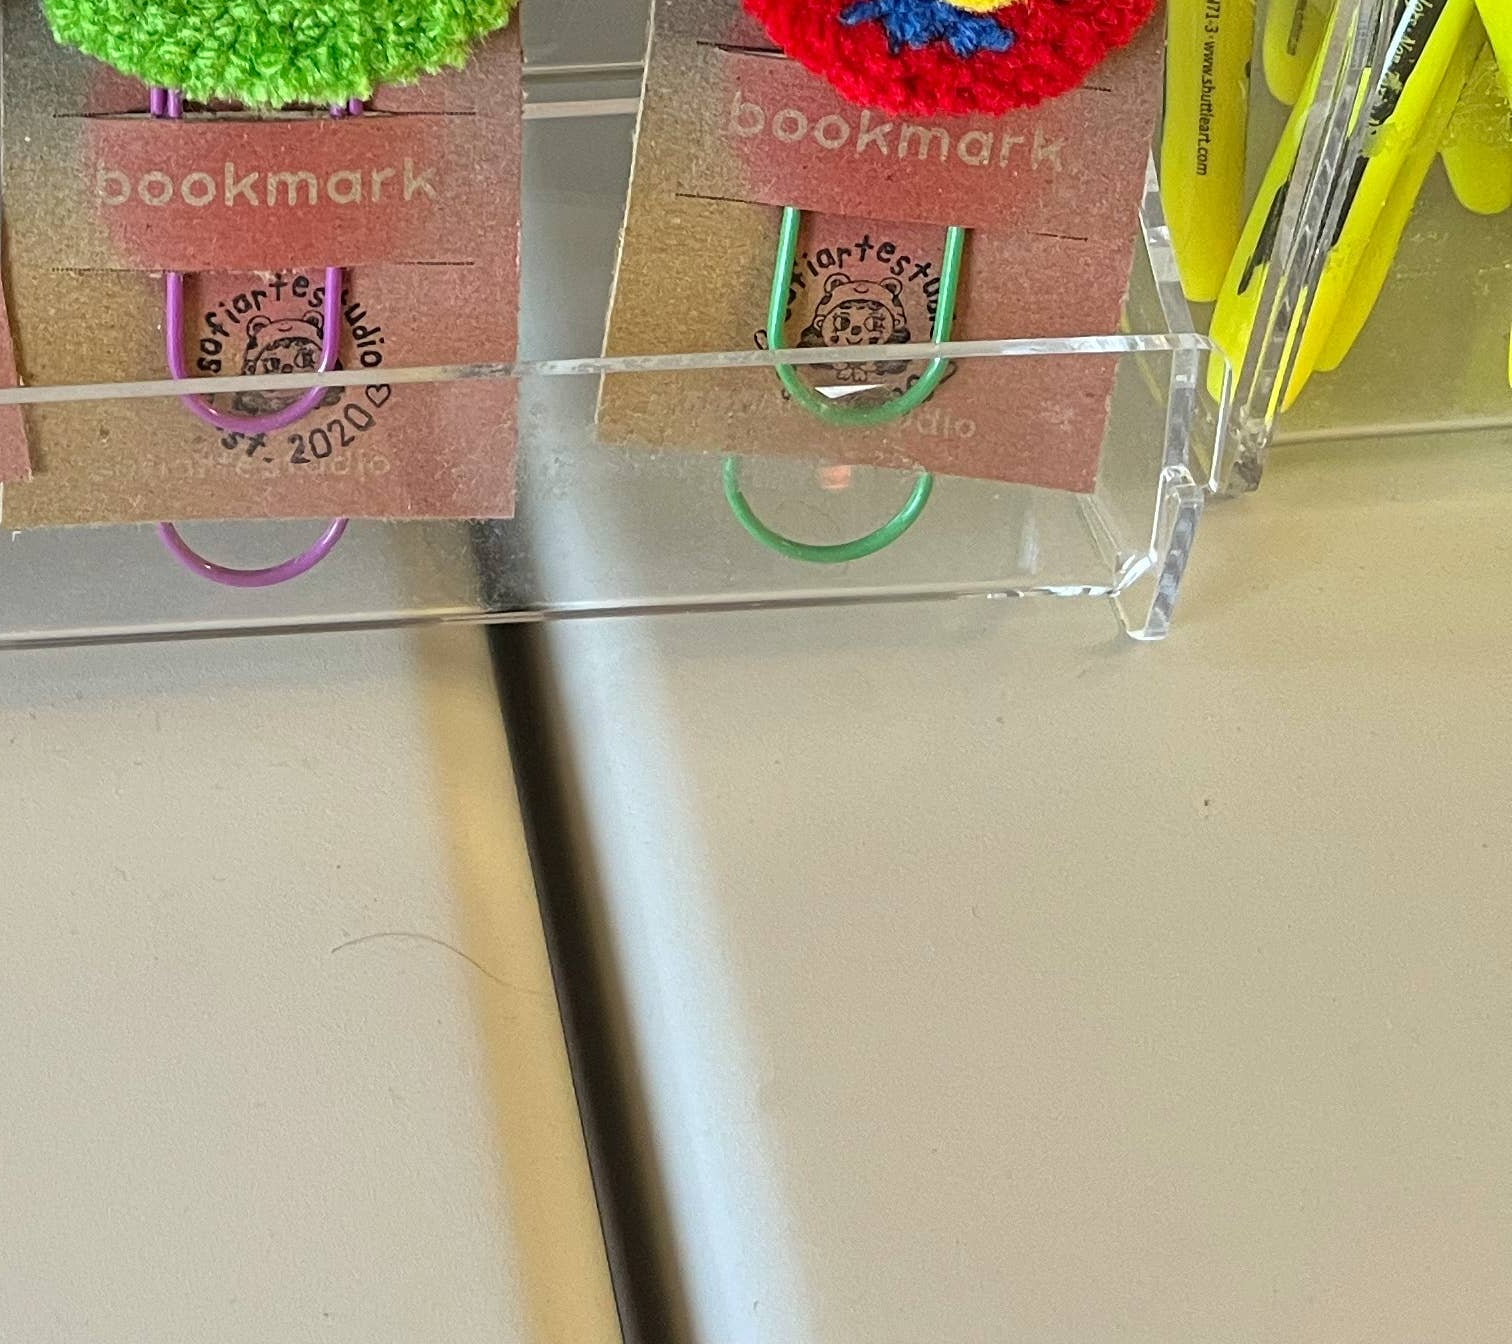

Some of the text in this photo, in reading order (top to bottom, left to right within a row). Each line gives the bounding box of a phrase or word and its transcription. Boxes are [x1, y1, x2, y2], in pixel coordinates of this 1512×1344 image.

[728, 90, 1067, 172] bookmark
[1196, 40, 1218, 176] www.shuttleart.com
[93, 157, 439, 208] bookmark
[196, 272, 385, 373] sofiartesudio
[288, 403, 377, 464] 2020
